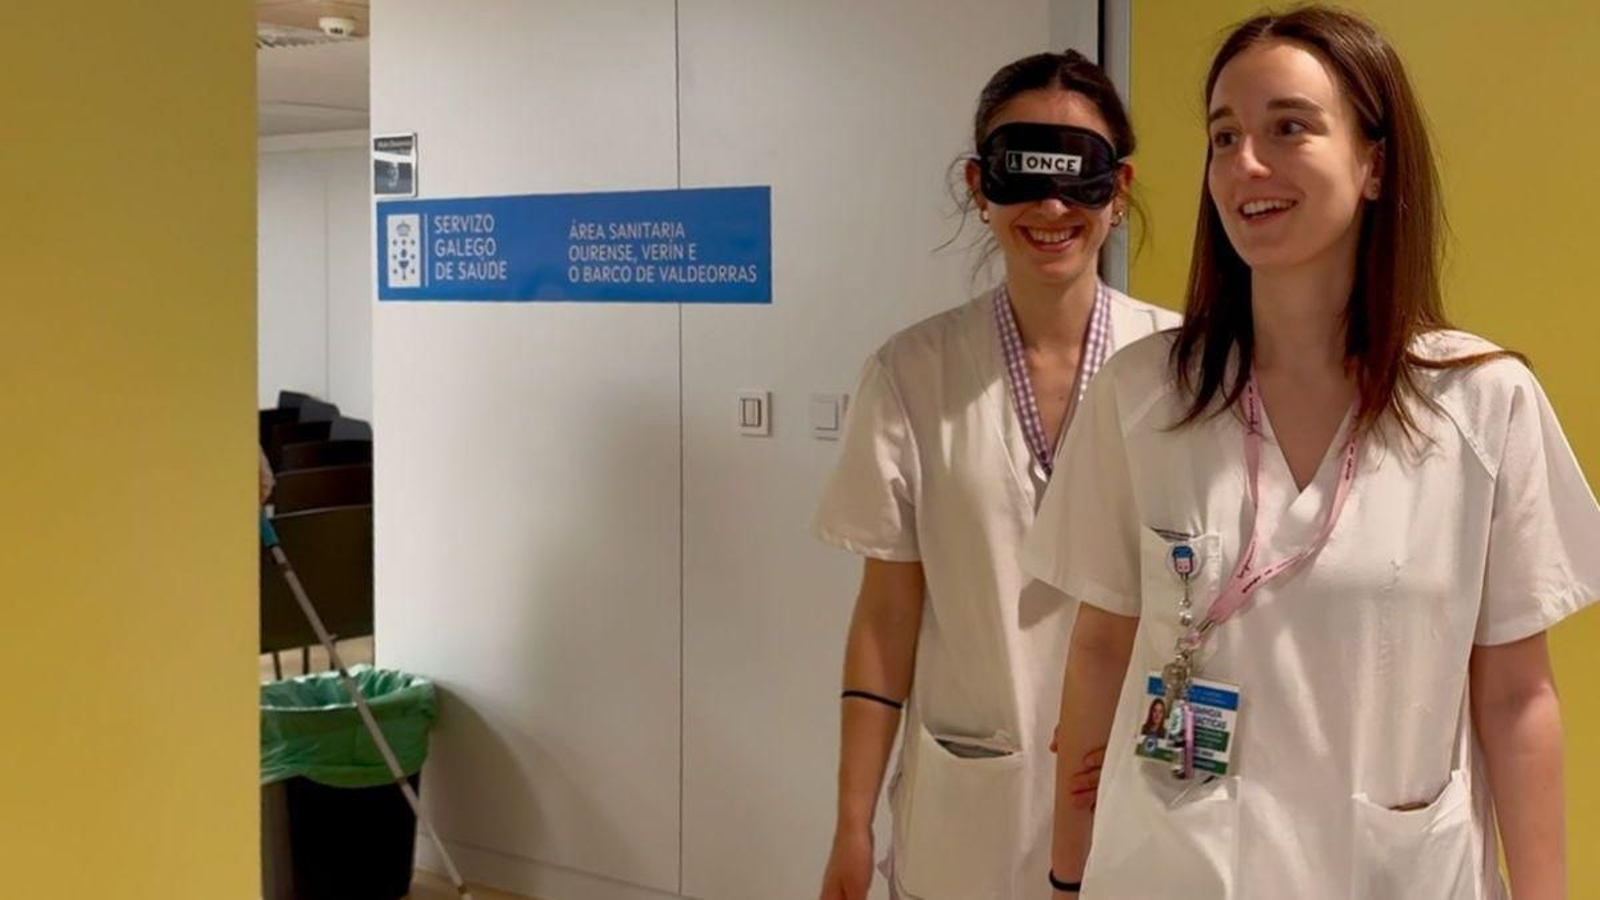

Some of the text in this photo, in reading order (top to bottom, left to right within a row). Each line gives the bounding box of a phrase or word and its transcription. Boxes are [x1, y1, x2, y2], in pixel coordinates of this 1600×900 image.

[1027, 156, 1077, 172] ONCE
[434, 214, 494, 234] SERVIZO
[569, 220, 685, 240] ÁREA SANITARIA
[435, 237, 497, 257] GALEGO
[569, 240, 697, 263] OURENSE, VERÍN E
[436, 257, 507, 280] DE SAÚDE
[569, 264, 757, 283] O BARCO DE VALDEORRAS
